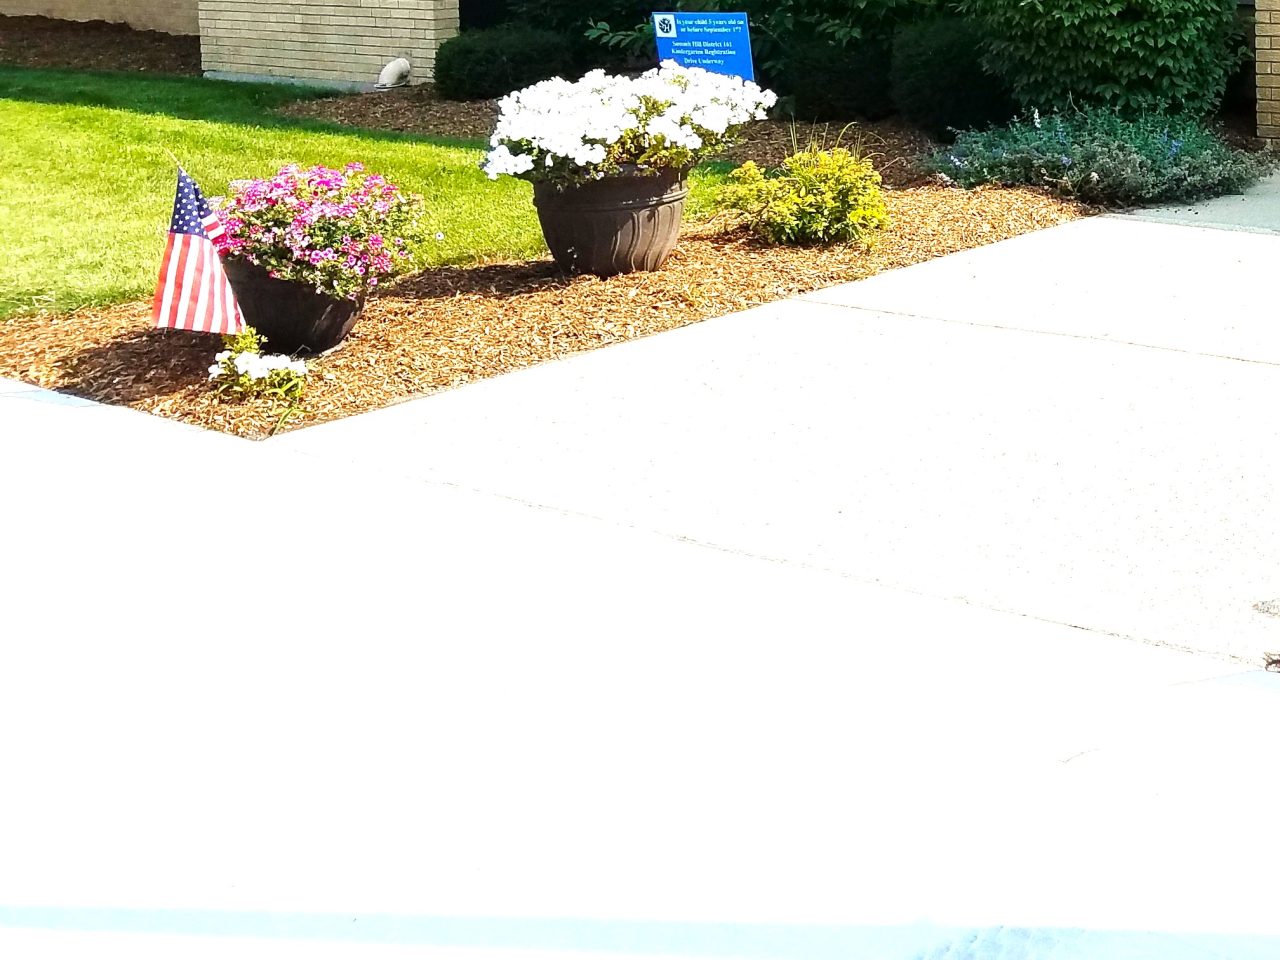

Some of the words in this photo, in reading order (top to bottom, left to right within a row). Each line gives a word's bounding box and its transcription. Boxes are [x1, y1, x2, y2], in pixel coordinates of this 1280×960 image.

[703, 26, 731, 34] September
[671, 48, 703, 56] Kindergarten
[704, 48, 736, 56] Registration
